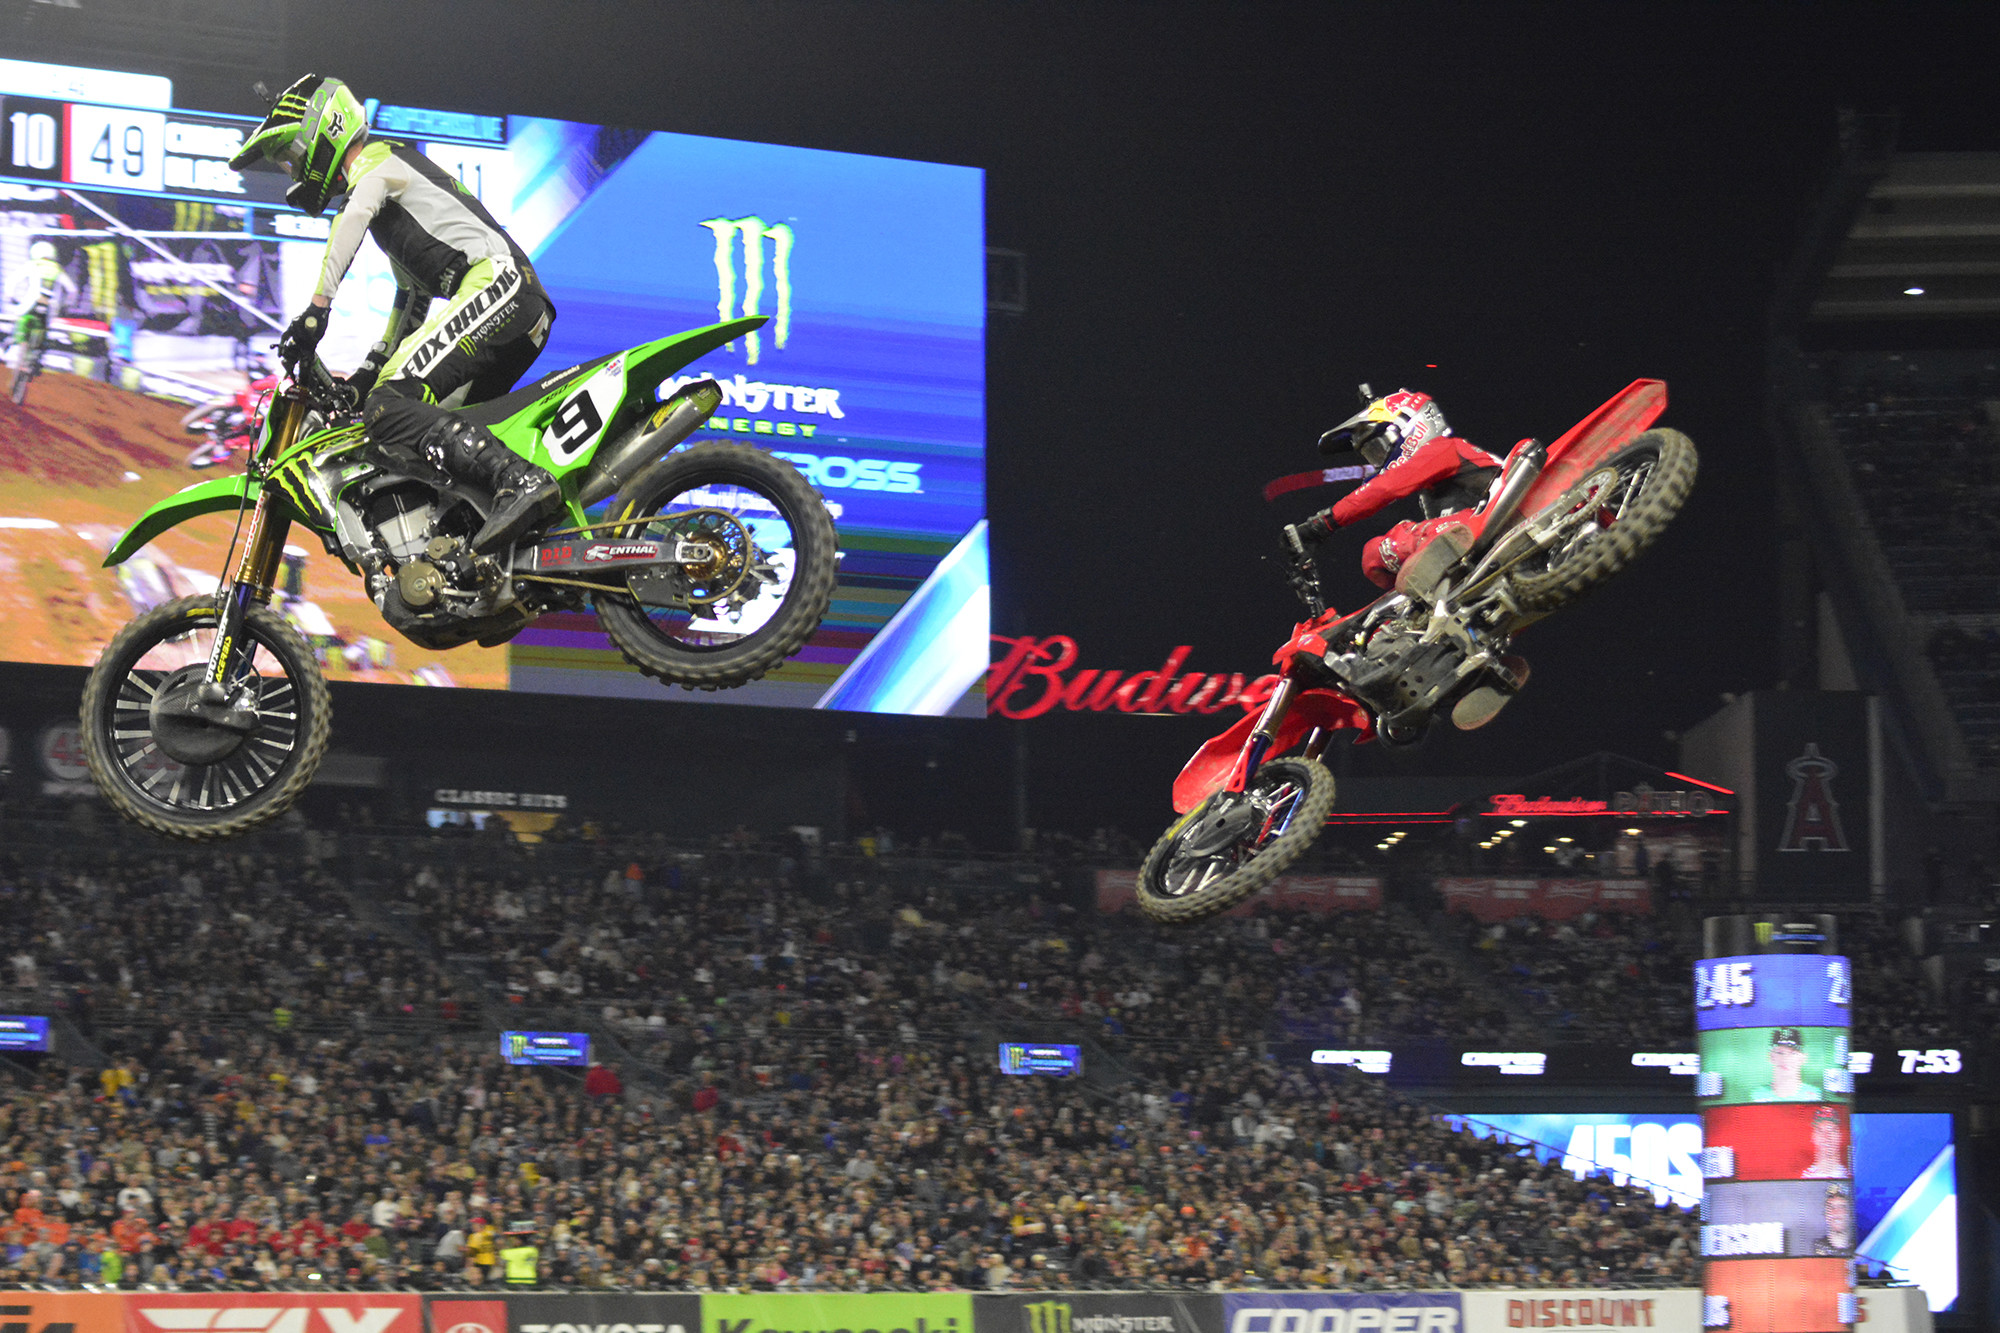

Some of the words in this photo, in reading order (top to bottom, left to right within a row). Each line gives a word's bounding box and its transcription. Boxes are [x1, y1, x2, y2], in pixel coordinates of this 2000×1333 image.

[9, 111, 57, 170] 10
[89, 122, 145, 177] 49
[444, 265, 519, 343] RACING
[472, 300, 520, 342] MONSTER
[540, 364, 581, 390] Kawasaki
[658, 371, 846, 420] MNSTER
[550, 389, 603, 455] 9
[702, 415, 818, 438] NERGY
[215, 635, 232, 684] ACERBIS
[1898, 1049, 1962, 1074] 7:53
[1507, 1299, 1657, 1328] DISCOUNT
